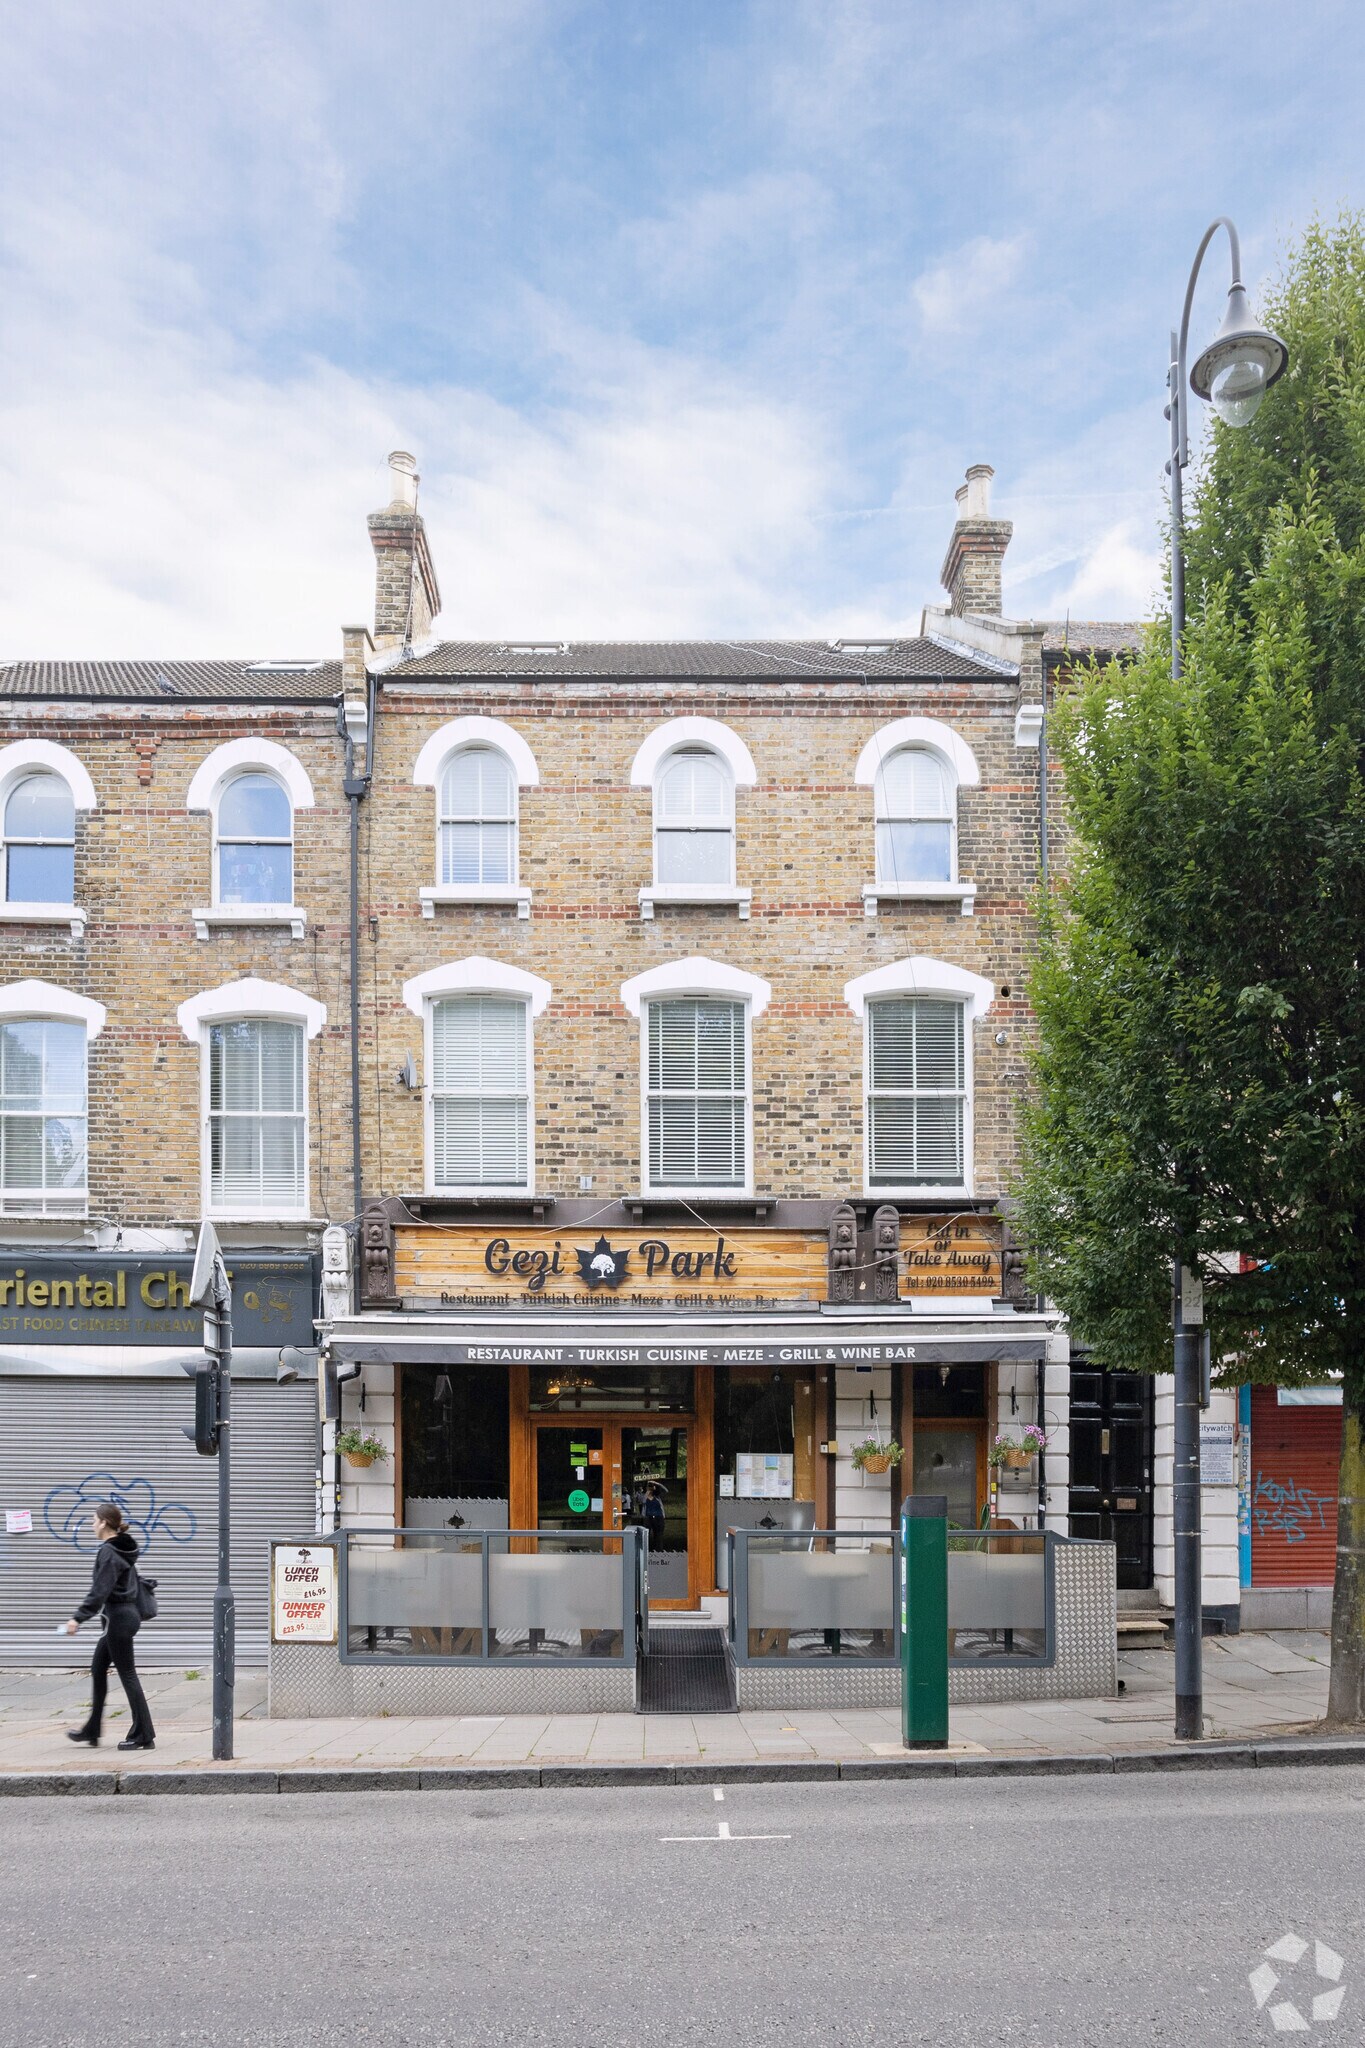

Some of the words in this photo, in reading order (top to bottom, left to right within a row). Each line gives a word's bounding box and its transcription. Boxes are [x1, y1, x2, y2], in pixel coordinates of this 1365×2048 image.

[926, 1223, 952, 1238] Eat
[954, 1225, 970, 1238] in
[934, 1241, 951, 1251] or
[484, 1238, 565, 1291] Gezi
[638, 1238, 738, 1277] Park
[904, 1249, 942, 1266] Take
[945, 1251, 991, 1272] Away
[0, 1269, 126, 1307] riental
[927, 1277, 943, 1288] 020
[945, 1277, 968, 1288] 8530
[439, 1292, 509, 1305] Restaurant
[521, 1293, 570, 1305] Turkish
[573, 1293, 620, 1305] Cuisine
[631, 1294, 664, 1306] Meze
[674, 1294, 702, 1306] Grill
[705, 1295, 715, 1306] &
[0, 1317, 19, 1330] ST
[24, 1318, 64, 1331] FOOD
[69, 1318, 130, 1332] CHINESE
[136, 1319, 204, 1332] TAKEAW
[467, 1347, 563, 1360] RESTAURANT
[578, 1349, 639, 1361] TURKISH
[646, 1349, 708, 1361] CUISINE
[723, 1349, 763, 1361] MEZE
[780, 1348, 822, 1360] GRILL
[825, 1348, 836, 1359] &
[841, 1347, 881, 1359] WINE
[885, 1346, 916, 1358] BAR
[633, 1473, 661, 1482] CLOSED
[284, 1566, 320, 1575] LUNCH
[303, 1587, 327, 1599] £16.95
[282, 1602, 326, 1611] DINNER
[286, 1610, 322, 1619] OFFER
[282, 1623, 305, 1634] £23.95
